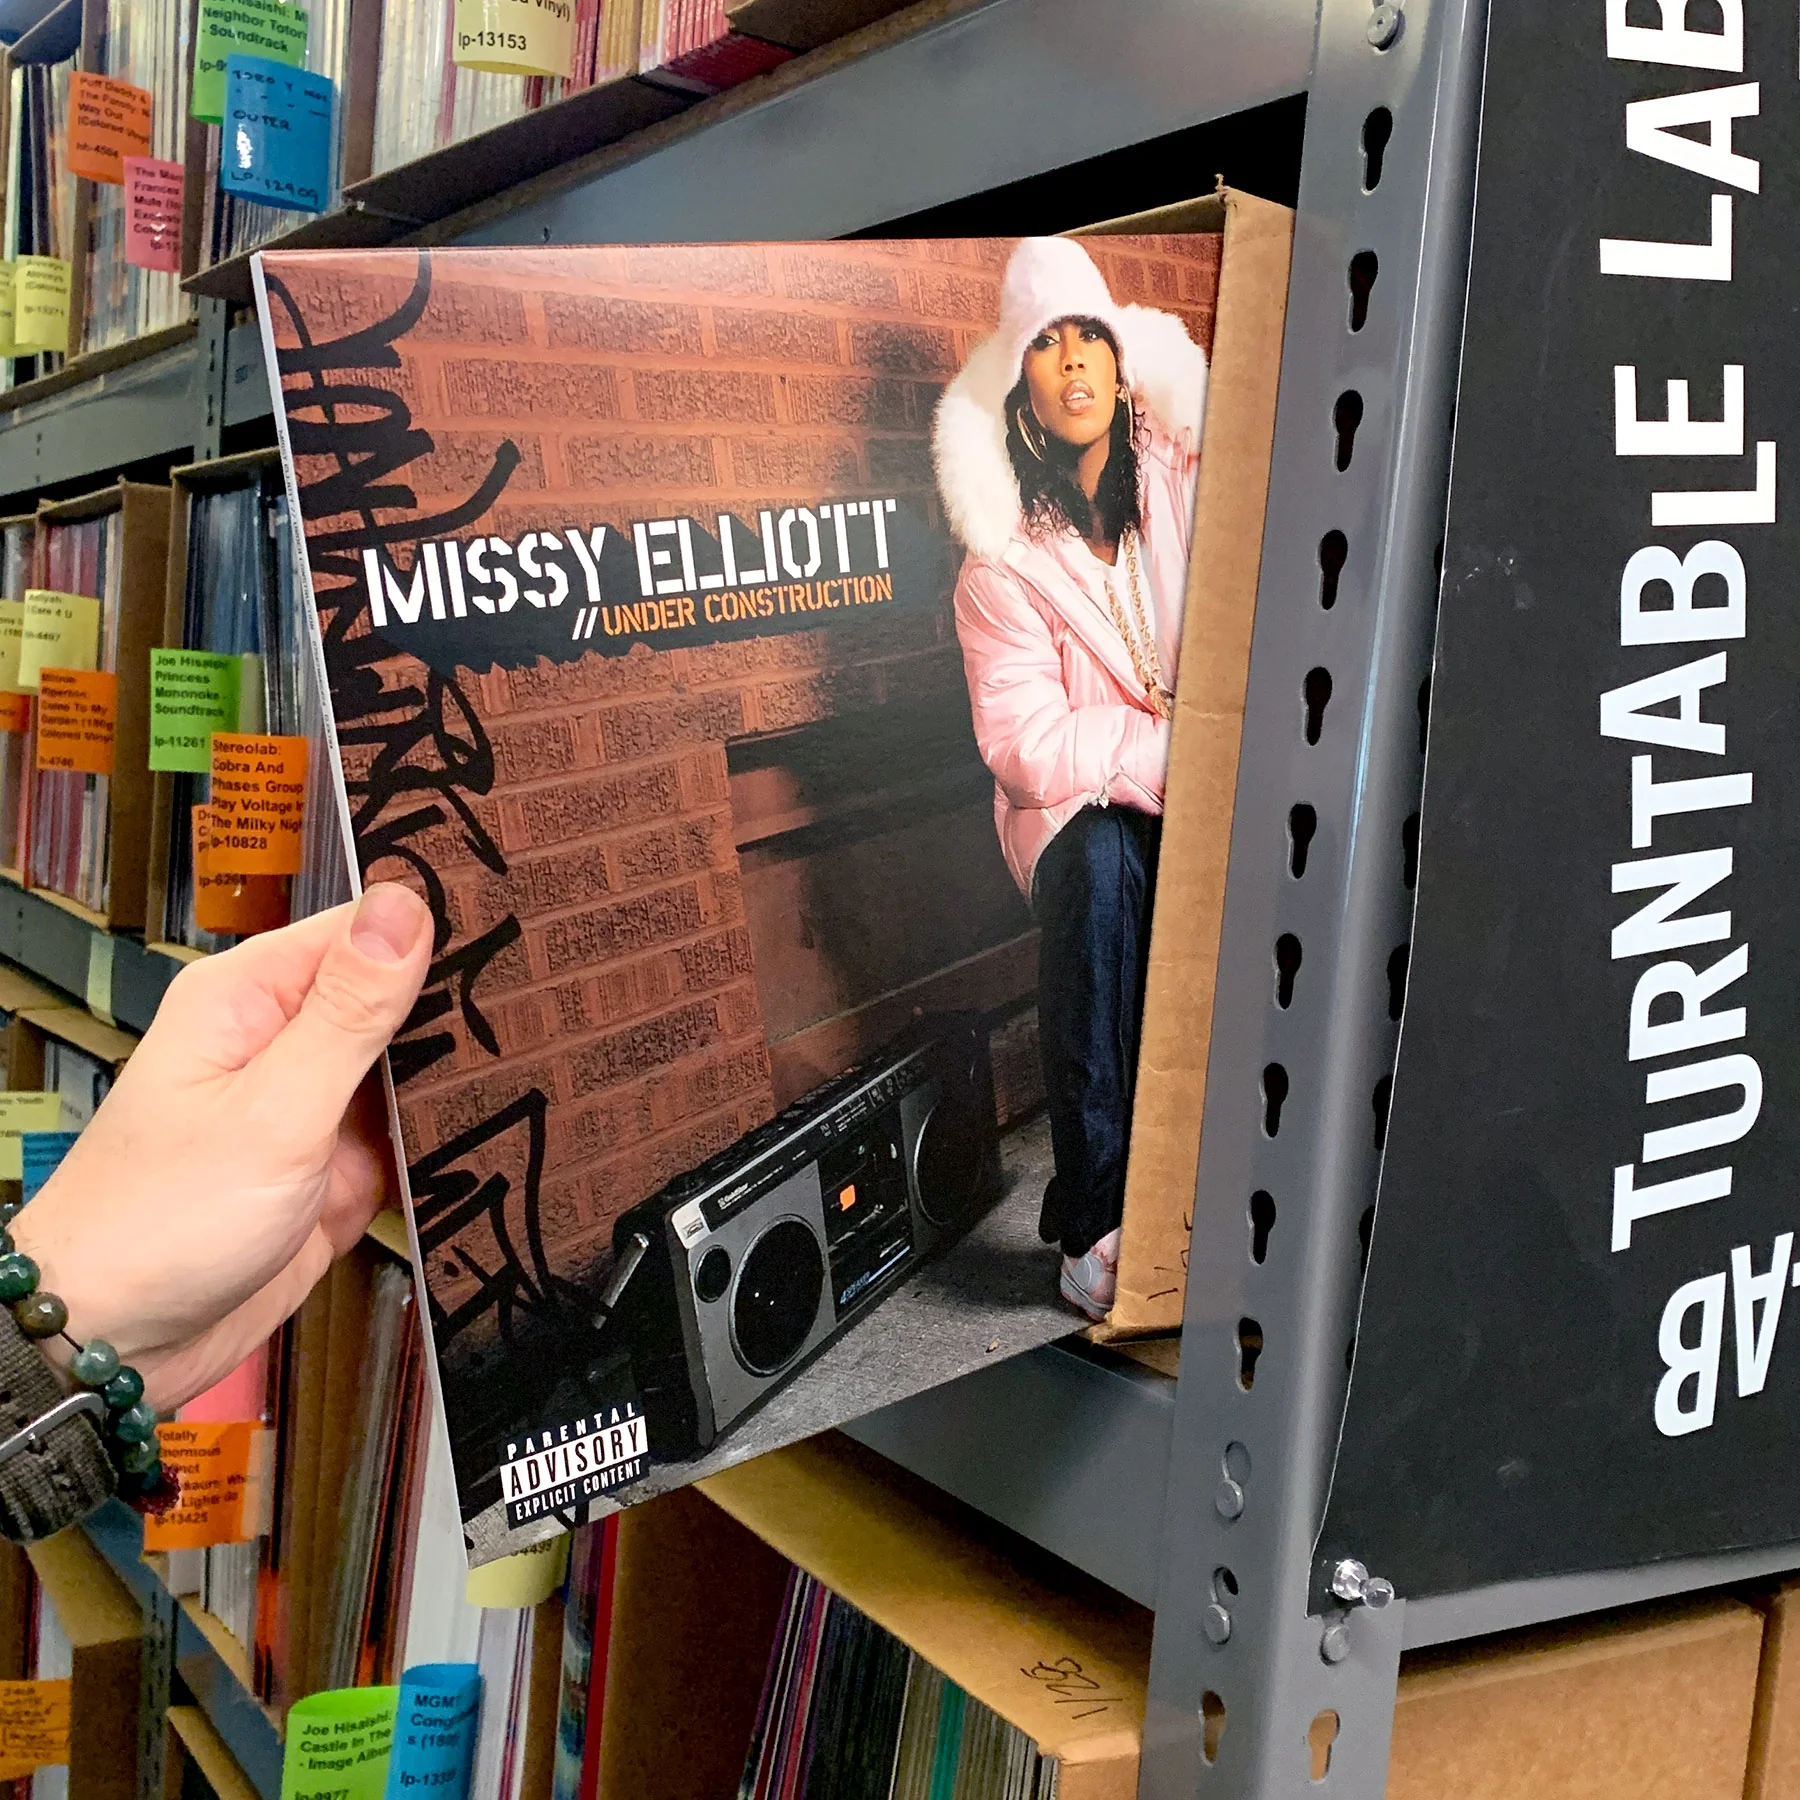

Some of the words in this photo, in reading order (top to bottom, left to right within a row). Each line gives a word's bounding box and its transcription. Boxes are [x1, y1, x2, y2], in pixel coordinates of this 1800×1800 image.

[203, 7, 265, 28] Neighbor
[269, 19, 308, 39] Totor
[208, 23, 289, 53] Soundtrack
[458, 31, 527, 51] lp-13153
[232, 109, 292, 131] OUTER
[1600, 0, 1760, 281] LAB
[362, 526, 607, 627] MISSY
[631, 498, 897, 597] ELLIOTT
[702, 573, 893, 623] CONSTRUCTION
[155, 655, 177, 667] Joe
[155, 670, 211, 685] Princess
[155, 686, 220, 700] Mononoke
[73, 702, 88, 713] To
[90, 704, 108, 717] My
[211, 739, 282, 756] Stereolab:
[211, 757, 251, 773] Cobra
[255, 761, 285, 774] And
[211, 776, 261, 793] Phases
[265, 779, 304, 796] Group
[211, 795, 237, 813] Play
[241, 798, 293, 815] Voltage
[1600, 364, 1777, 1253] TURNTABLE
[210, 813, 233, 829] The
[236, 816, 276, 834] Milky
[210, 834, 268, 851] lp-10828
[1654, 1231, 1800, 1437] AB
[506, 1402, 636, 1461] PARENTAL
[510, 1421, 639, 1498] ADVISORY
[515, 1483, 577, 1521] EXPLICIT
[583, 1458, 642, 1496] CONTENT
[302, 1724, 330, 1737] Joe
[334, 1709, 393, 1734] Hisaishi:
[300, 1739, 350, 1754] Castle
[352, 1736, 365, 1748] In
[369, 1728, 392, 1743] The
[308, 1756, 354, 1773] Image
